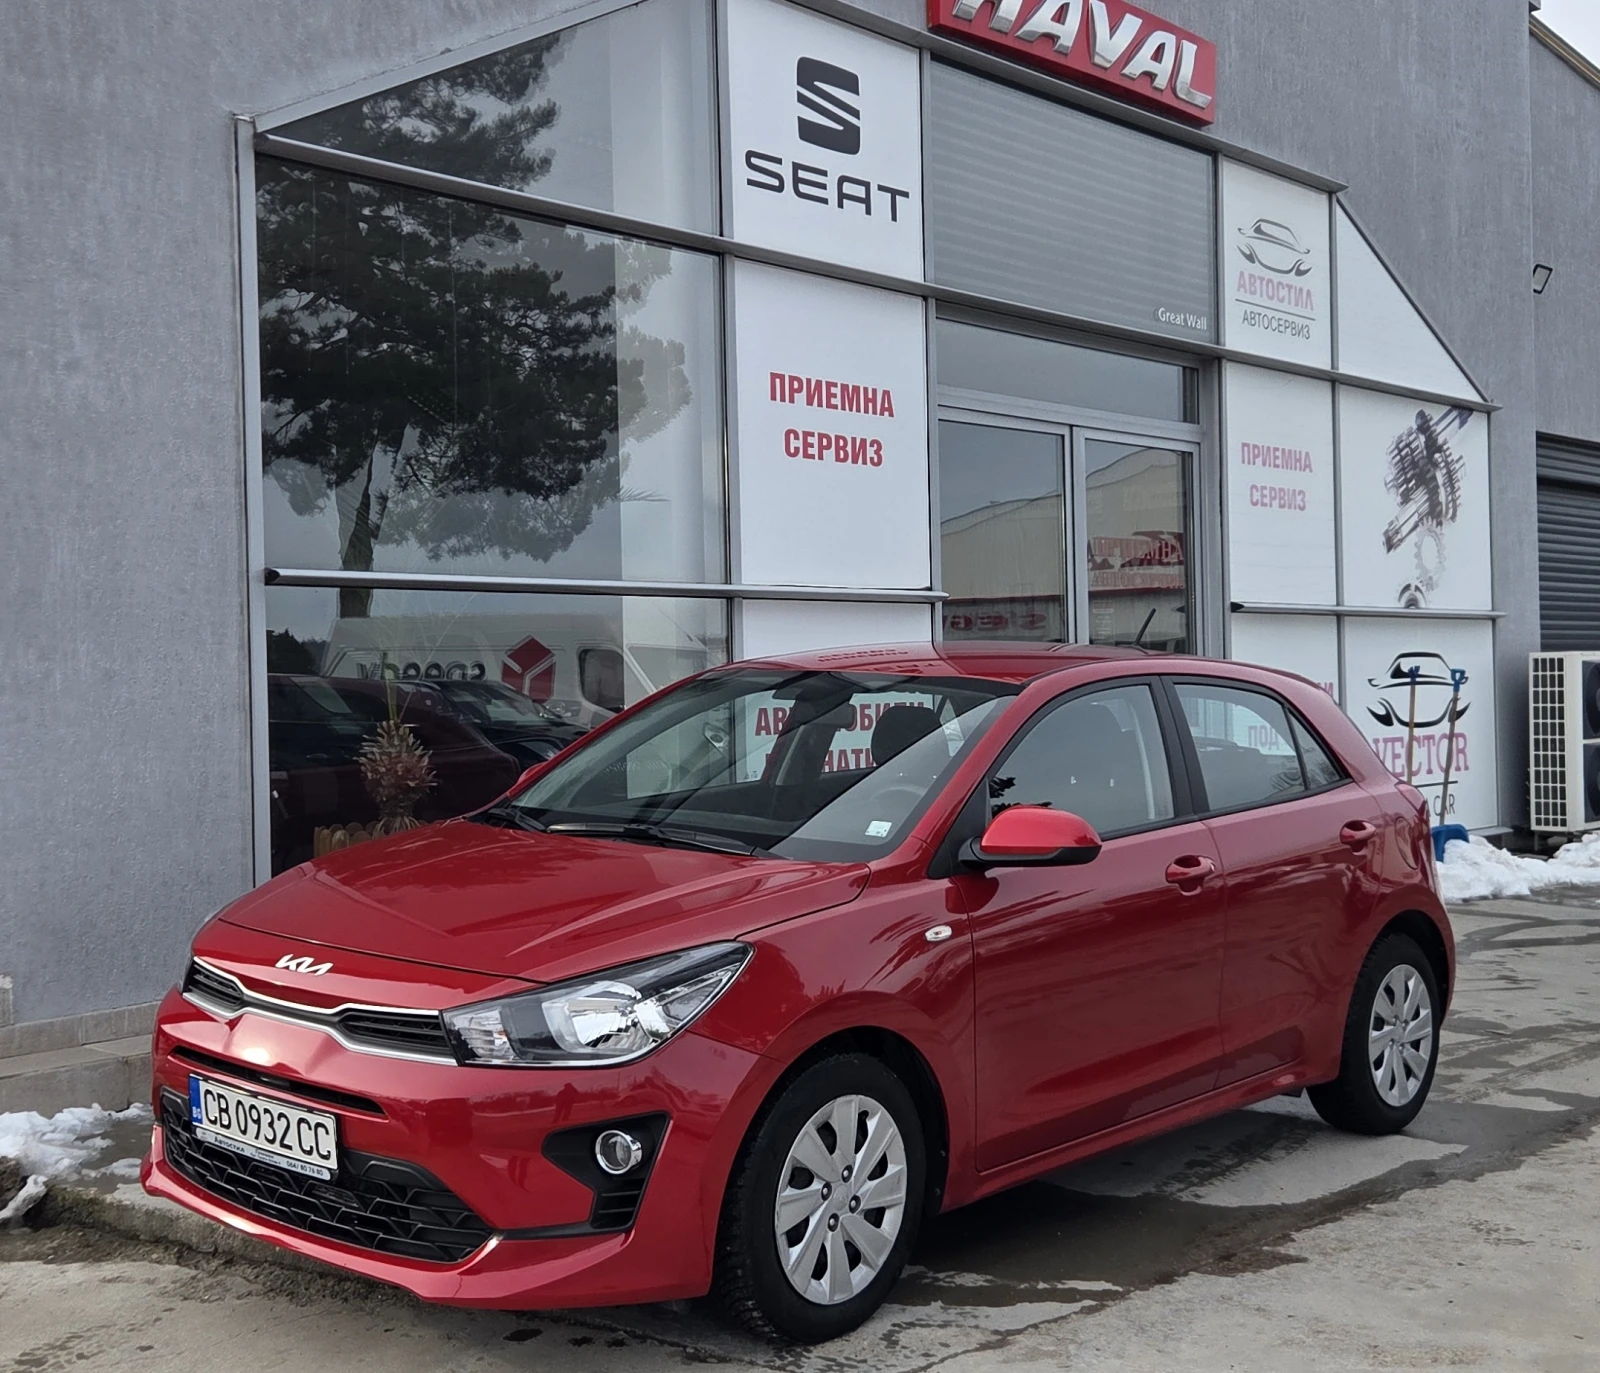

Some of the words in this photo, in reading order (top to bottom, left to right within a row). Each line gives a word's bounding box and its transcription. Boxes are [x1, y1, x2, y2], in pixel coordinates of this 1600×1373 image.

[745, 149, 909, 222] SEAT
[1237, 270, 1314, 312] АВТОСТИЛ
[1158, 307, 1185, 326] Great
[1186, 313, 1207, 330] Wall
[1242, 310, 1310, 340] АВТОСЕРВИЗ
[769, 371, 895, 418] ПРИЕМНА
[784, 428, 883, 467] СЕРВИЗ
[1241, 442, 1313, 473] ПРИЕМНА
[1250, 484, 1306, 511] СЕРВИЗ
[1372, 732, 1470, 778] VECTOR
[1433, 793, 1456, 817] CR
[204, 1088, 232, 1131] CB
[235, 1099, 294, 1151] 0932
[297, 1117, 332, 1161] CC
